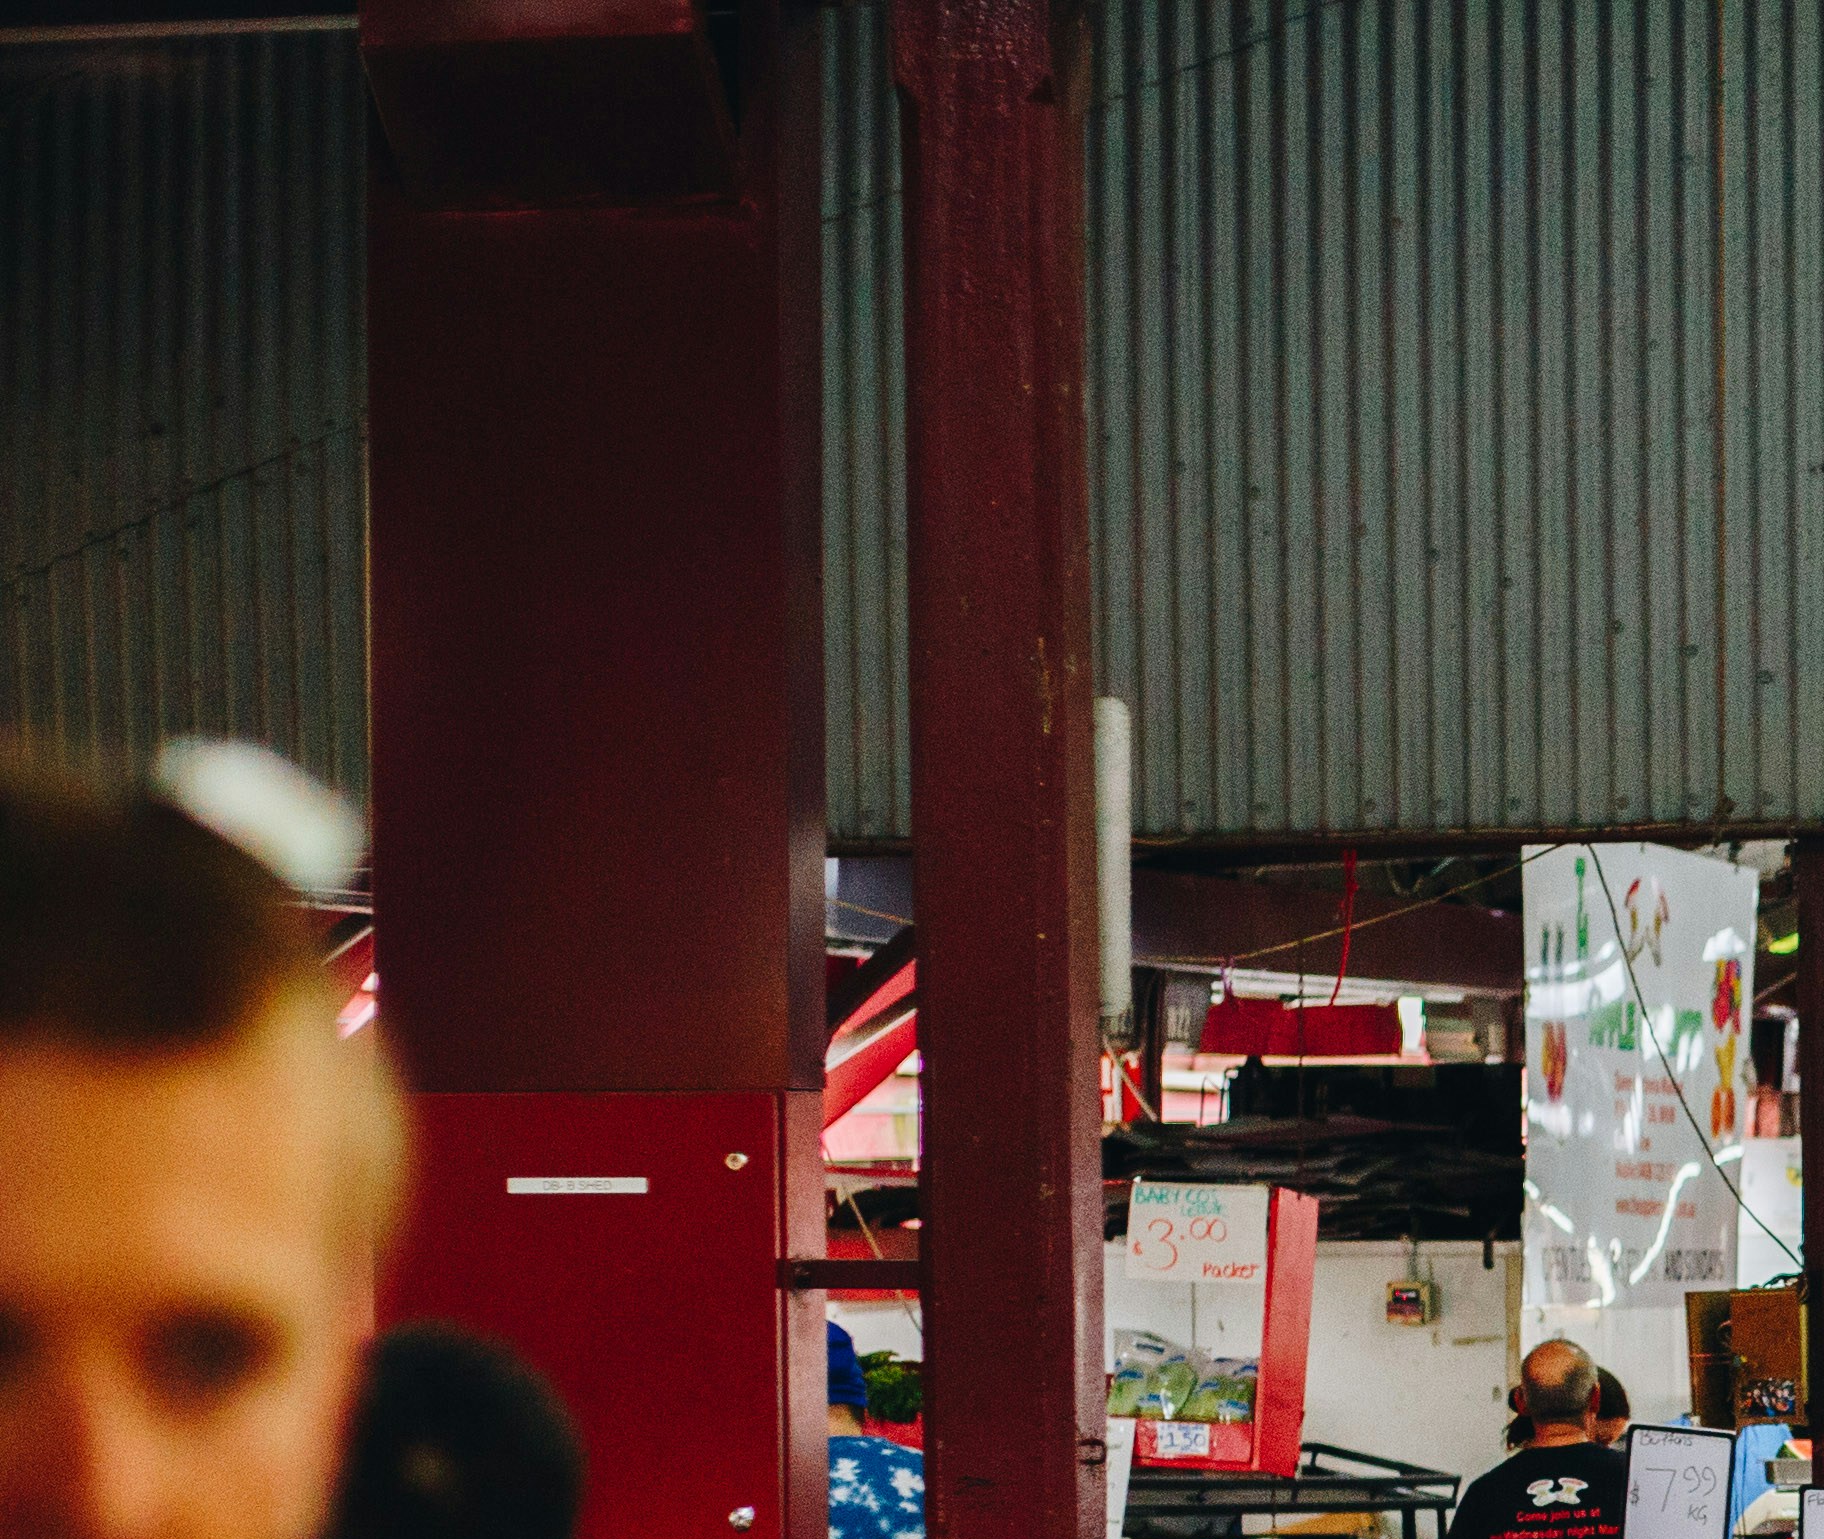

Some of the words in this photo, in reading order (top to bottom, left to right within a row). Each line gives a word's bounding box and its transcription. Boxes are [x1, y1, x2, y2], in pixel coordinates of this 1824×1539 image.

[1515, 1511, 1548, 1523] Come
[1549, 1509, 1571, 1523] join
[1573, 1509, 1587, 1519] us
[1566, 1525, 1596, 1539] night
